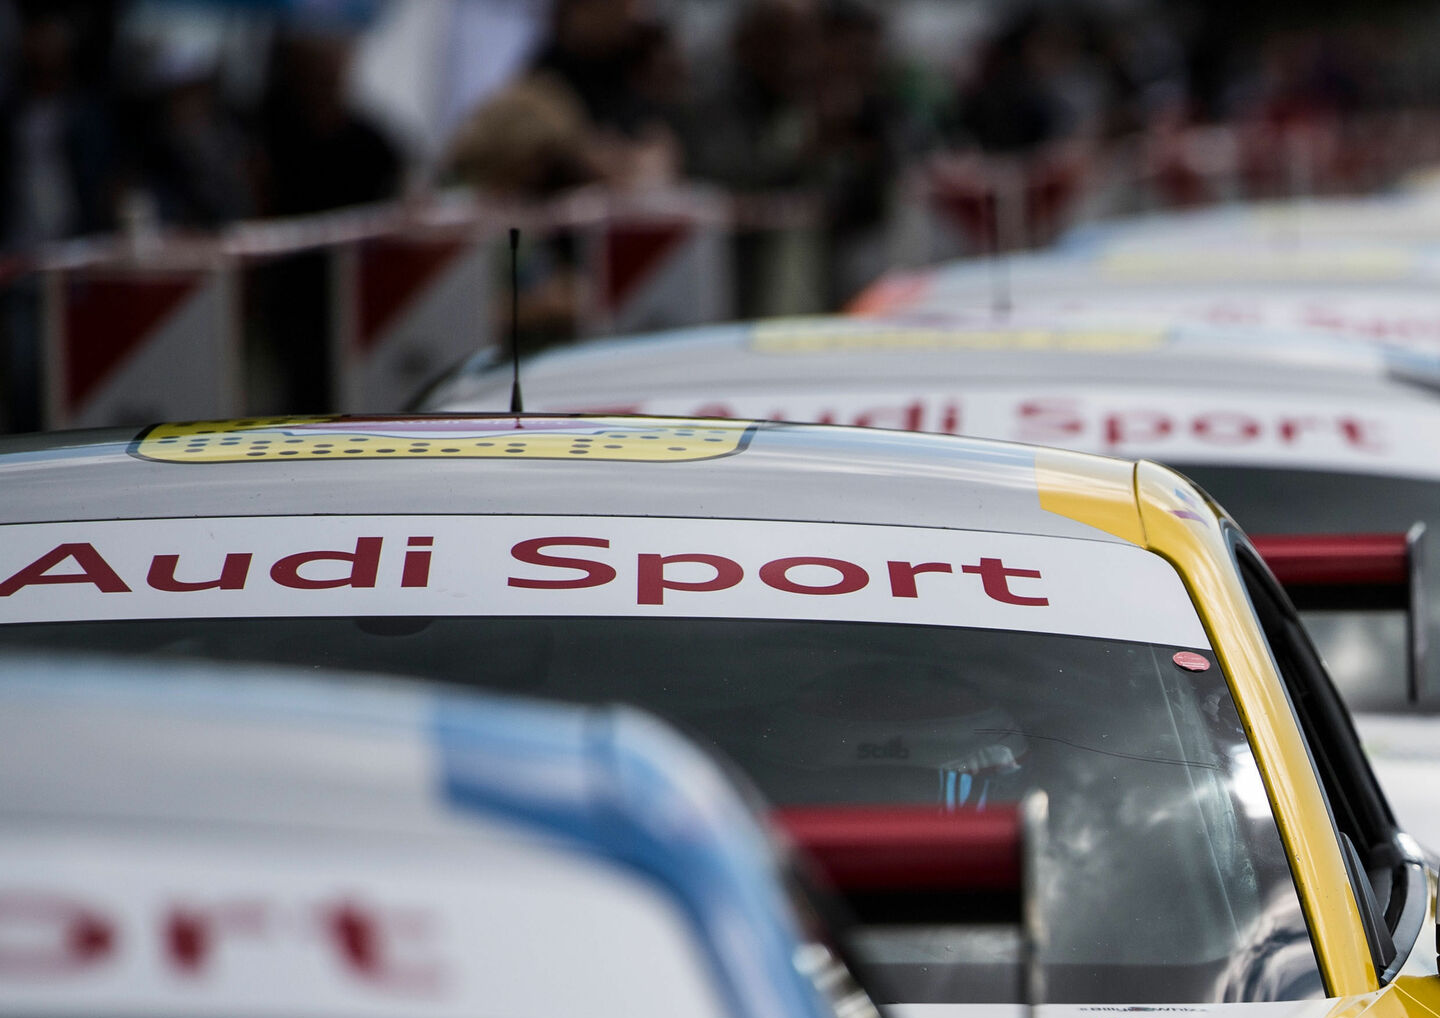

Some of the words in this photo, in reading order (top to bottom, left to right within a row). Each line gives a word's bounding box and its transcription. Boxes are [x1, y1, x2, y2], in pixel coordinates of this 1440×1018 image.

[1016, 396, 1392, 455] Sport
[0, 536, 434, 597] Audi
[507, 536, 1050, 607] Sport
